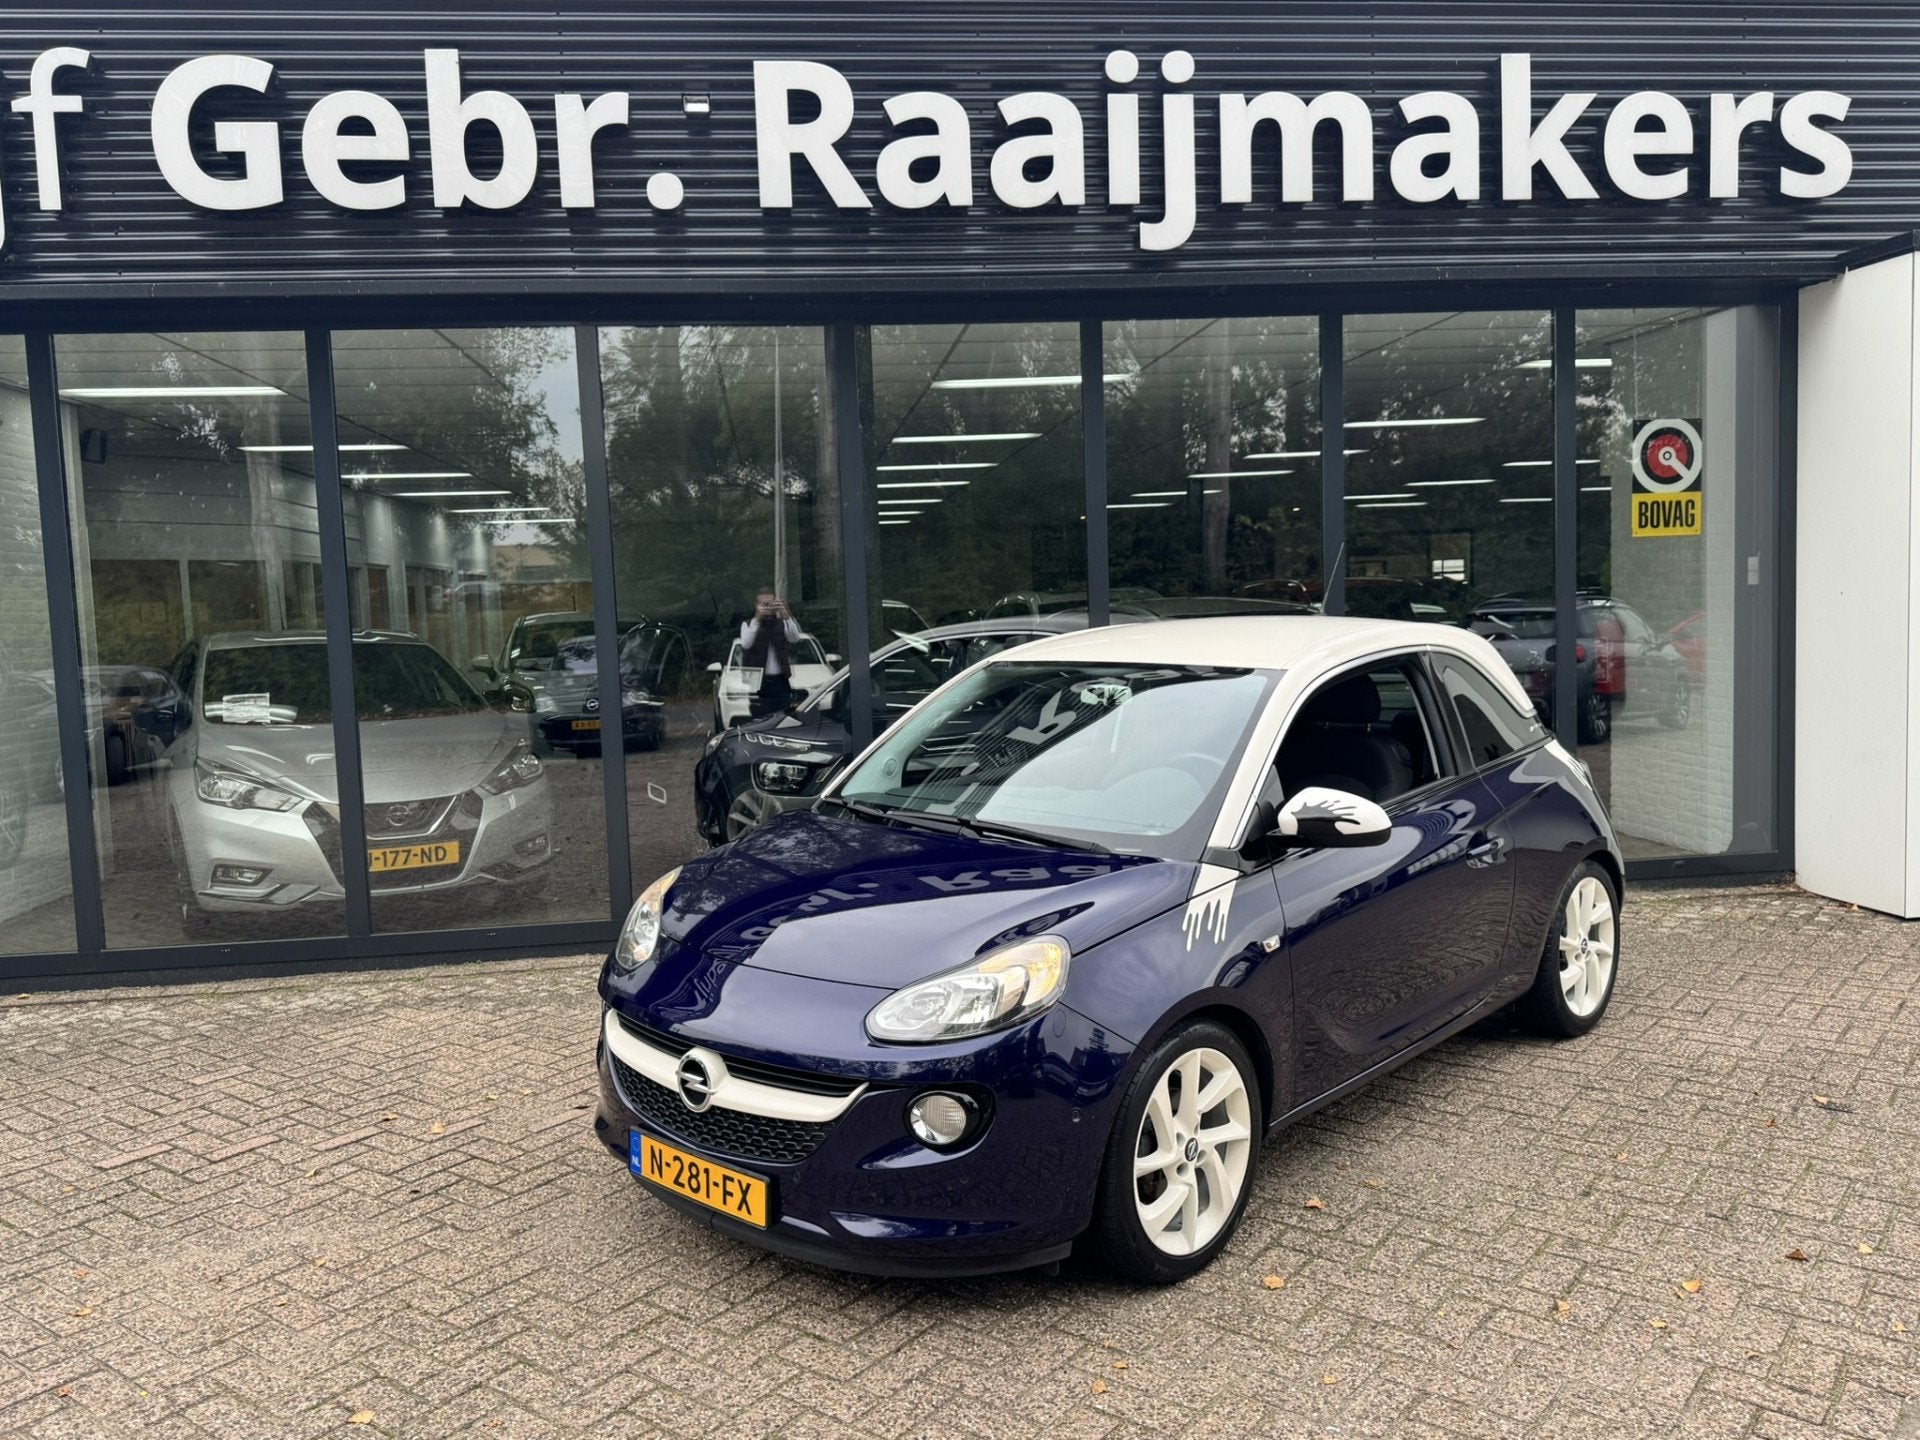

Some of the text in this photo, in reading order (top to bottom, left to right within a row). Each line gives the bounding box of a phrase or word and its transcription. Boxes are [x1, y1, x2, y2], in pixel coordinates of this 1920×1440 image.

[0, 47, 1853, 251] f Gebr. Raaijmakers
[1638, 499, 1696, 529] BOVAG
[650, 1144, 752, 1216] N-281-FX
